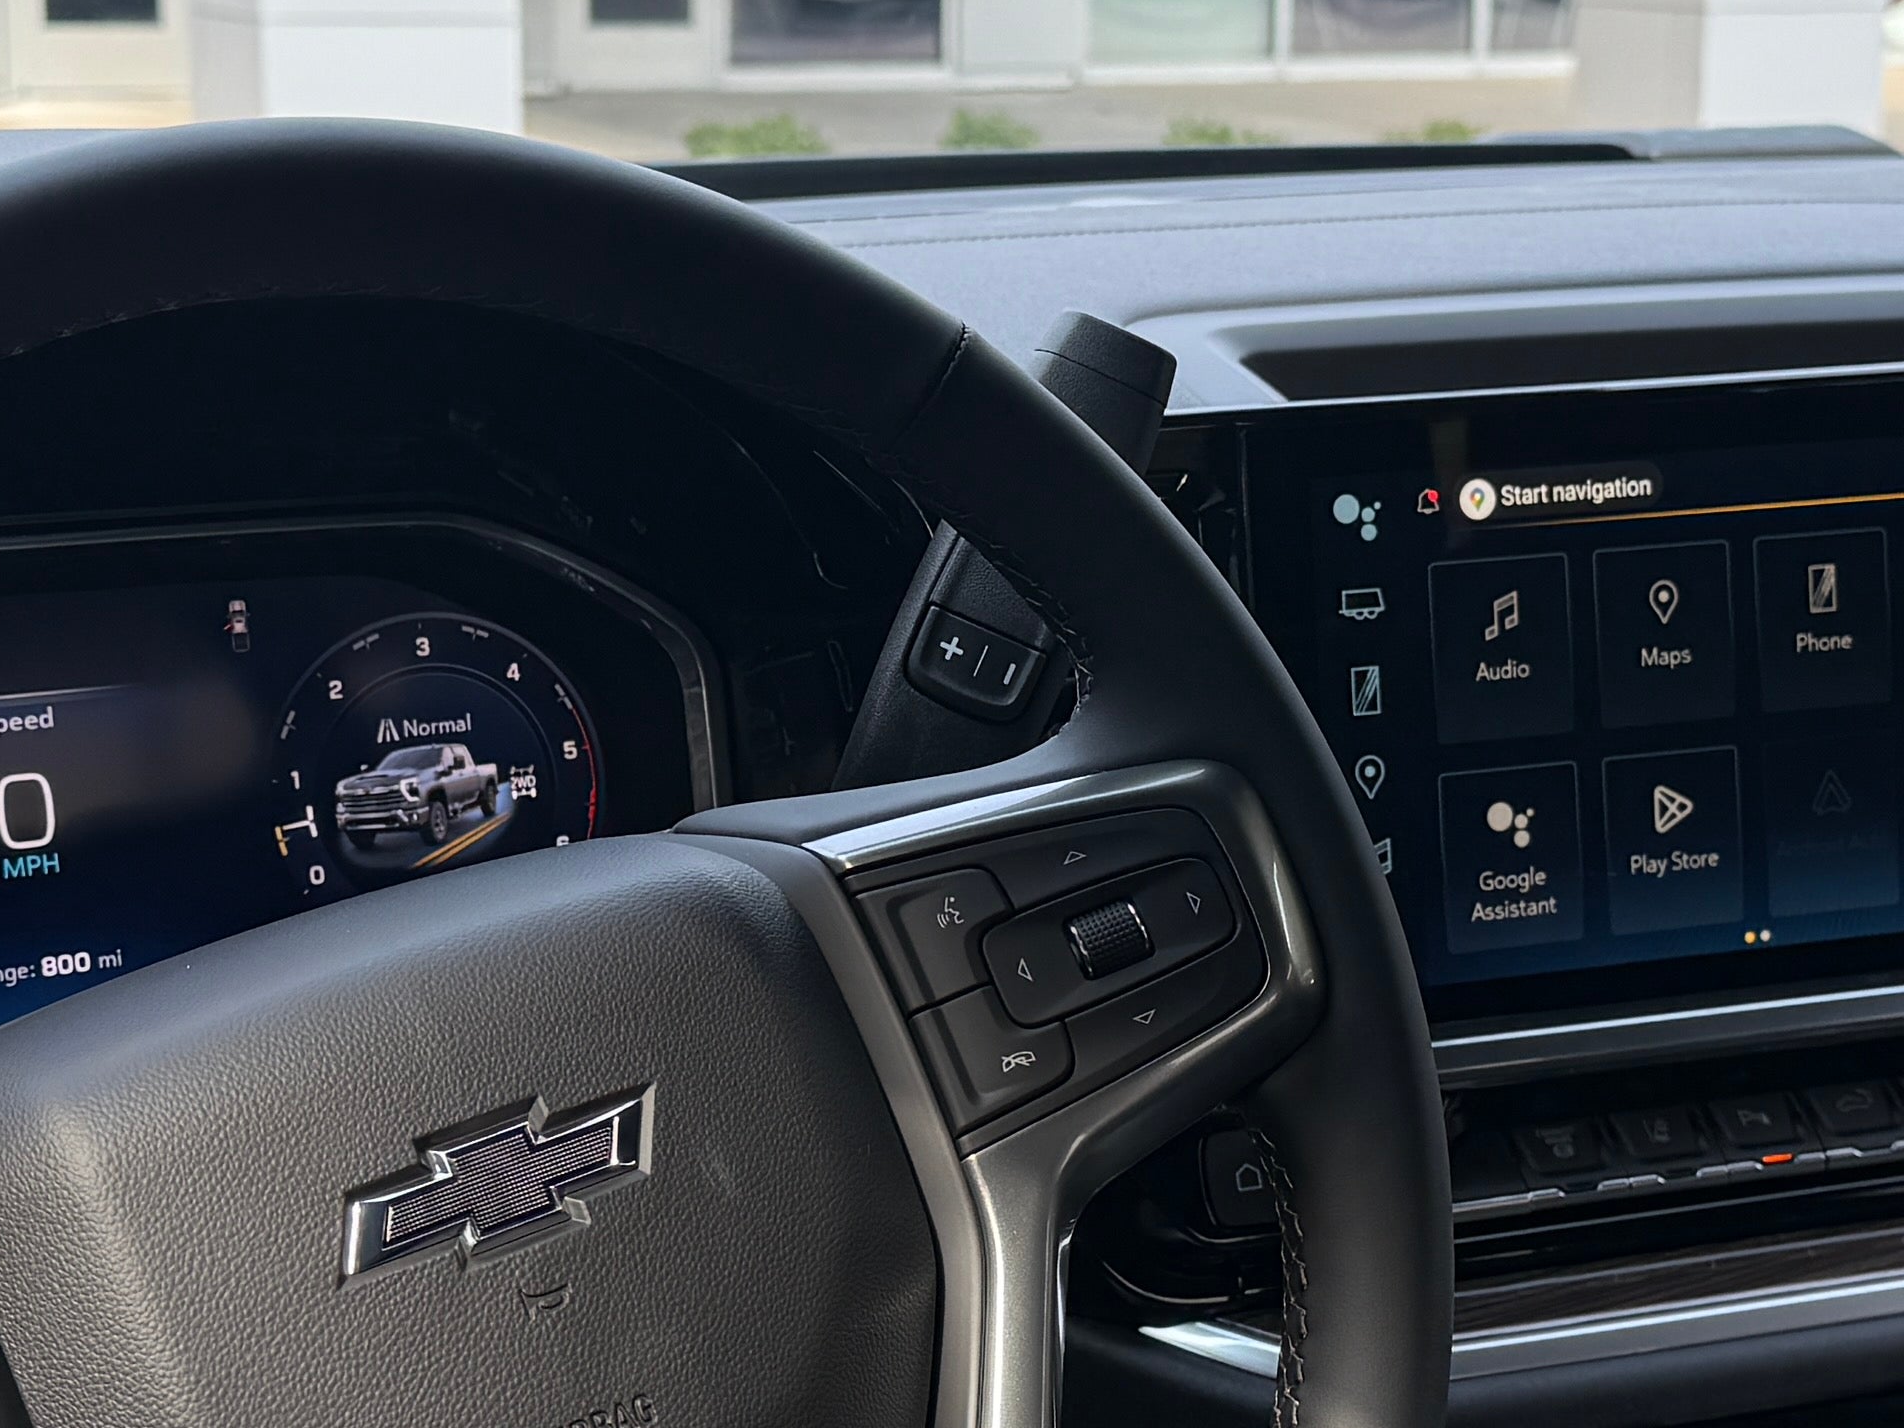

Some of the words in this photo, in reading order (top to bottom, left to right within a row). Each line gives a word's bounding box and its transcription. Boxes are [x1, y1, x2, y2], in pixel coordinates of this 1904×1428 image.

[1500, 483, 1550, 508] Start
[1552, 477, 1653, 505] navigation
[414, 637, 431, 657] 3
[1796, 631, 1854, 654] Phone
[1640, 646, 1692, 670] Maps
[506, 663, 521, 682] 4
[1476, 660, 1531, 683] Audio
[327, 680, 344, 701] 2
[402, 713, 472, 740] Normal
[562, 740, 578, 760] 5
[290, 770, 300, 790] 1
[509, 774, 537, 790] 2WD
[2, 852, 60, 880] MPH
[308, 864, 326, 886] 0
[1630, 852, 1669, 878] Play
[1671, 850, 1720, 873] Store
[1479, 868, 1548, 896] Google
[1471, 897, 1558, 924] Assistant
[40, 951, 92, 978] 800
[97, 948, 124, 971] mi
